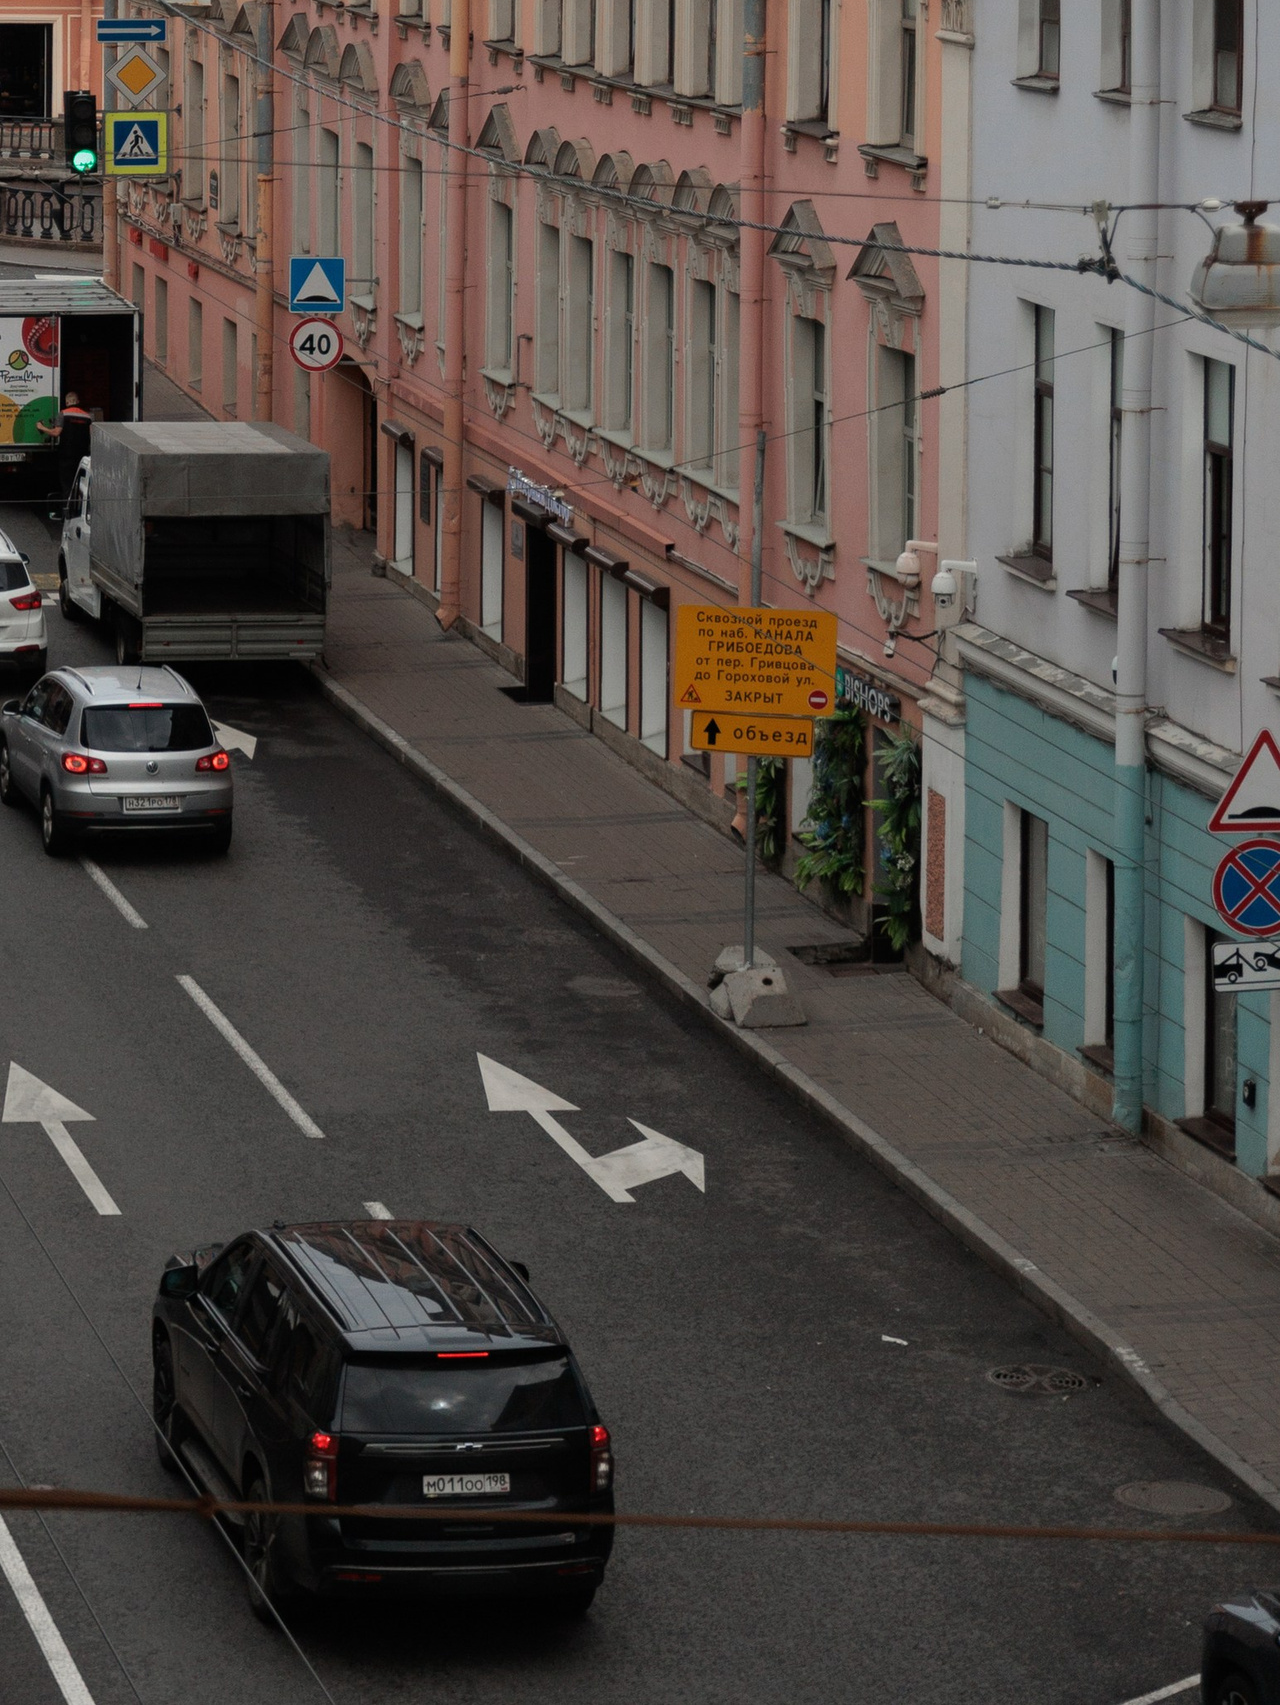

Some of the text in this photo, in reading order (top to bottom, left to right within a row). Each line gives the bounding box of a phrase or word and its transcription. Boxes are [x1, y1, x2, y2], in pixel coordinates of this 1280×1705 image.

[299, 334, 331, 355] 40
[697, 611, 817, 629] Сквозной проезд
[698, 628, 814, 642] по наб. КАНАЛА
[708, 640, 802, 655] ГРИБОЕДОВА
[696, 657, 815, 671] от пер. Гривцова
[694, 670, 815, 687] до Гороховой ул.
[725, 690, 783, 704] ЗАКРЫТ
[844, 674, 891, 723] BISHOPS
[733, 725, 807, 745] объезд
[426, 1475, 506, 1492] М011ОО 198
